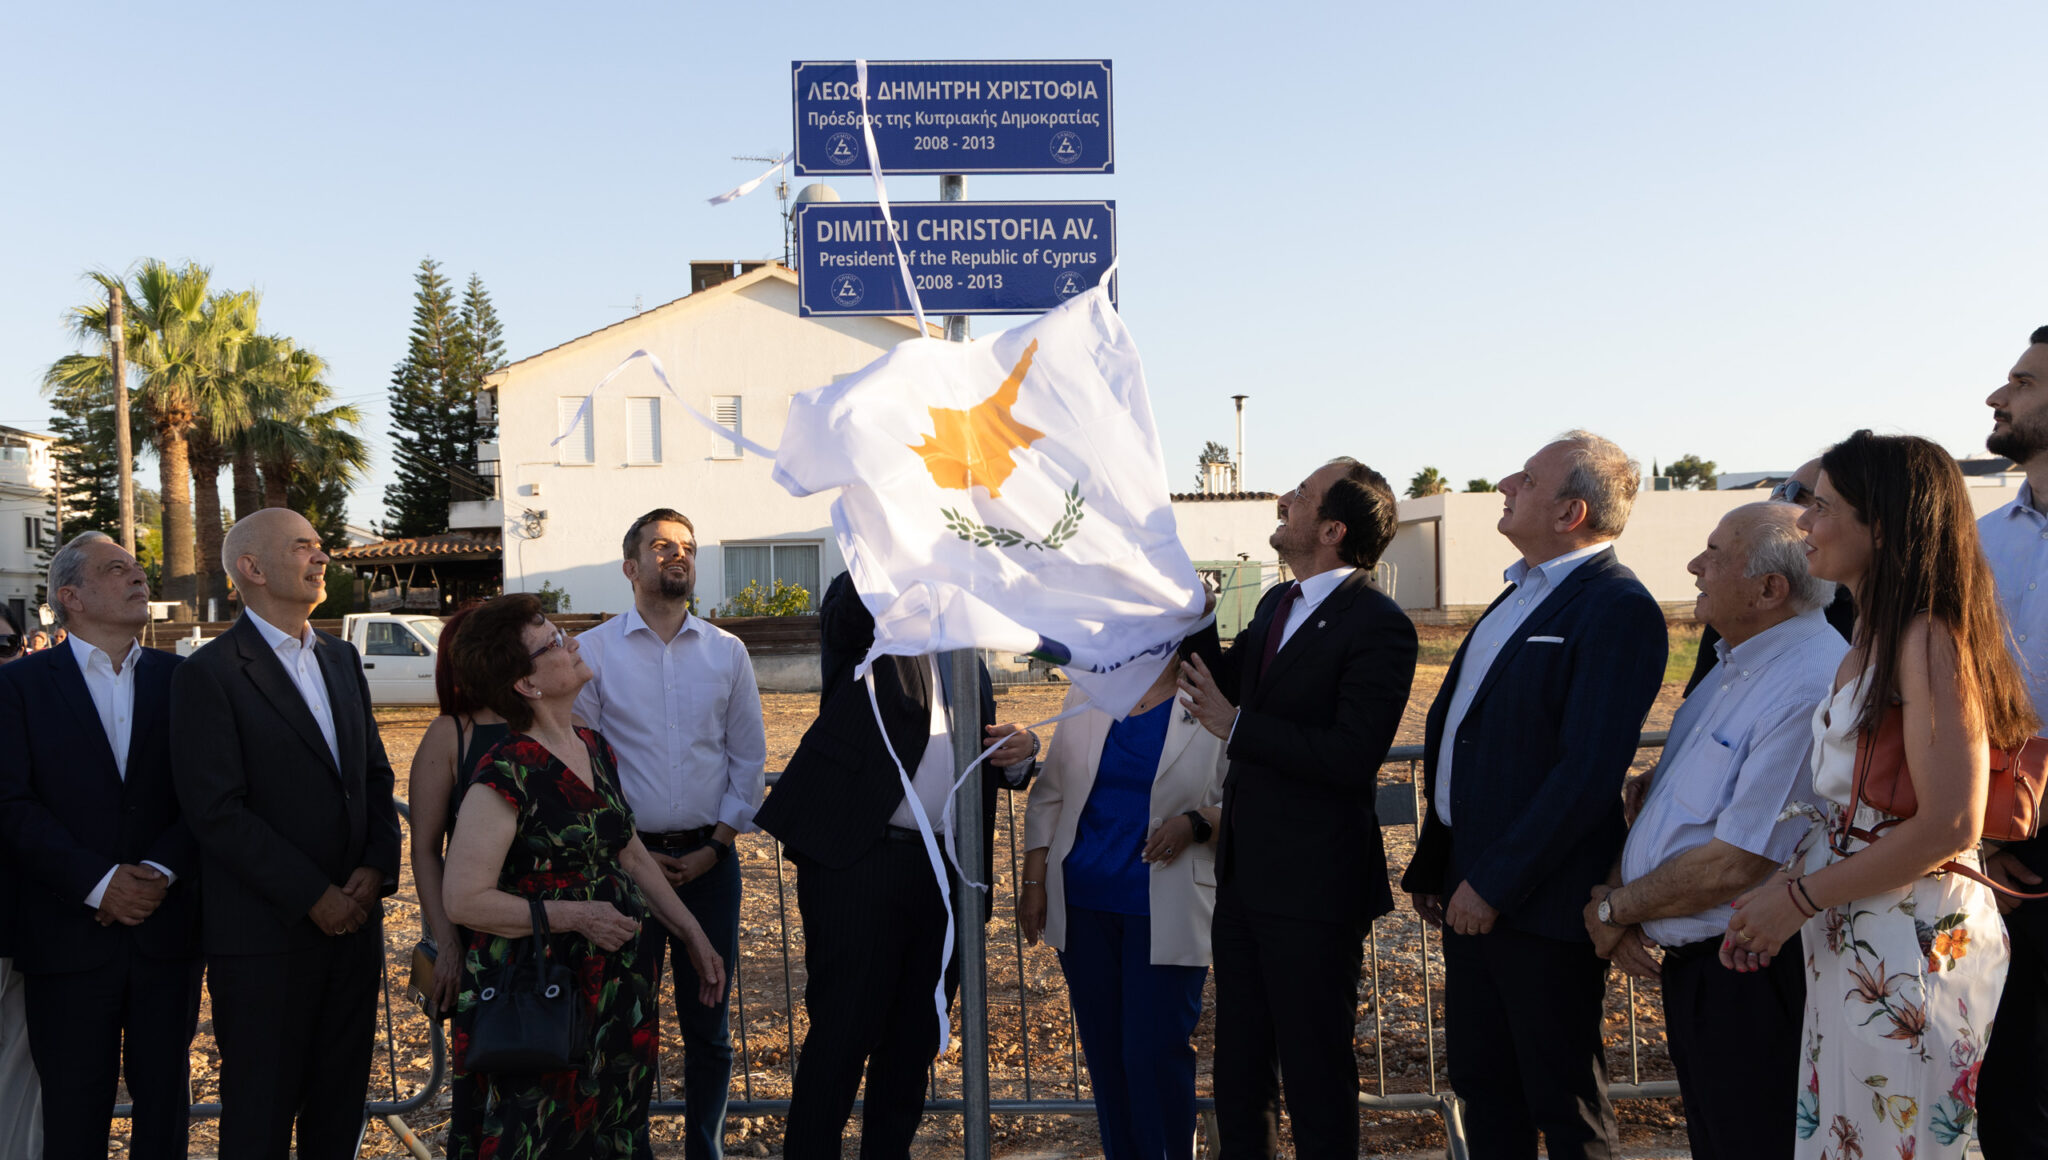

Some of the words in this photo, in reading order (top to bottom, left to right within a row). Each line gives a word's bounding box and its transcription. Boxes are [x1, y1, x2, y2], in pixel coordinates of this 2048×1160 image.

[877, 81, 981, 101] ΔΗΜΗΤΡΗ
[986, 80, 1099, 100] ΧΡΙΣΤΟΦΙΑ
[808, 110, 882, 130] Πρόεδρος
[885, 113, 912, 129] της
[915, 109, 998, 129] Κυπριακής
[1000, 109, 1100, 129] Δημοκρατίας
[914, 135, 949, 150] 2008
[961, 135, 996, 150] 2013
[816, 219, 909, 242] DIMITRI
[916, 218, 1057, 241] CHRISTOFIA
[1062, 217, 1099, 240] AV.
[819, 250, 896, 267] President
[920, 249, 947, 266] the
[951, 248, 1019, 270] Republic
[1022, 248, 1040, 265] of
[1042, 248, 1097, 269] Cyprus
[915, 274, 954, 290] 2008
[967, 273, 1004, 289] 2013
